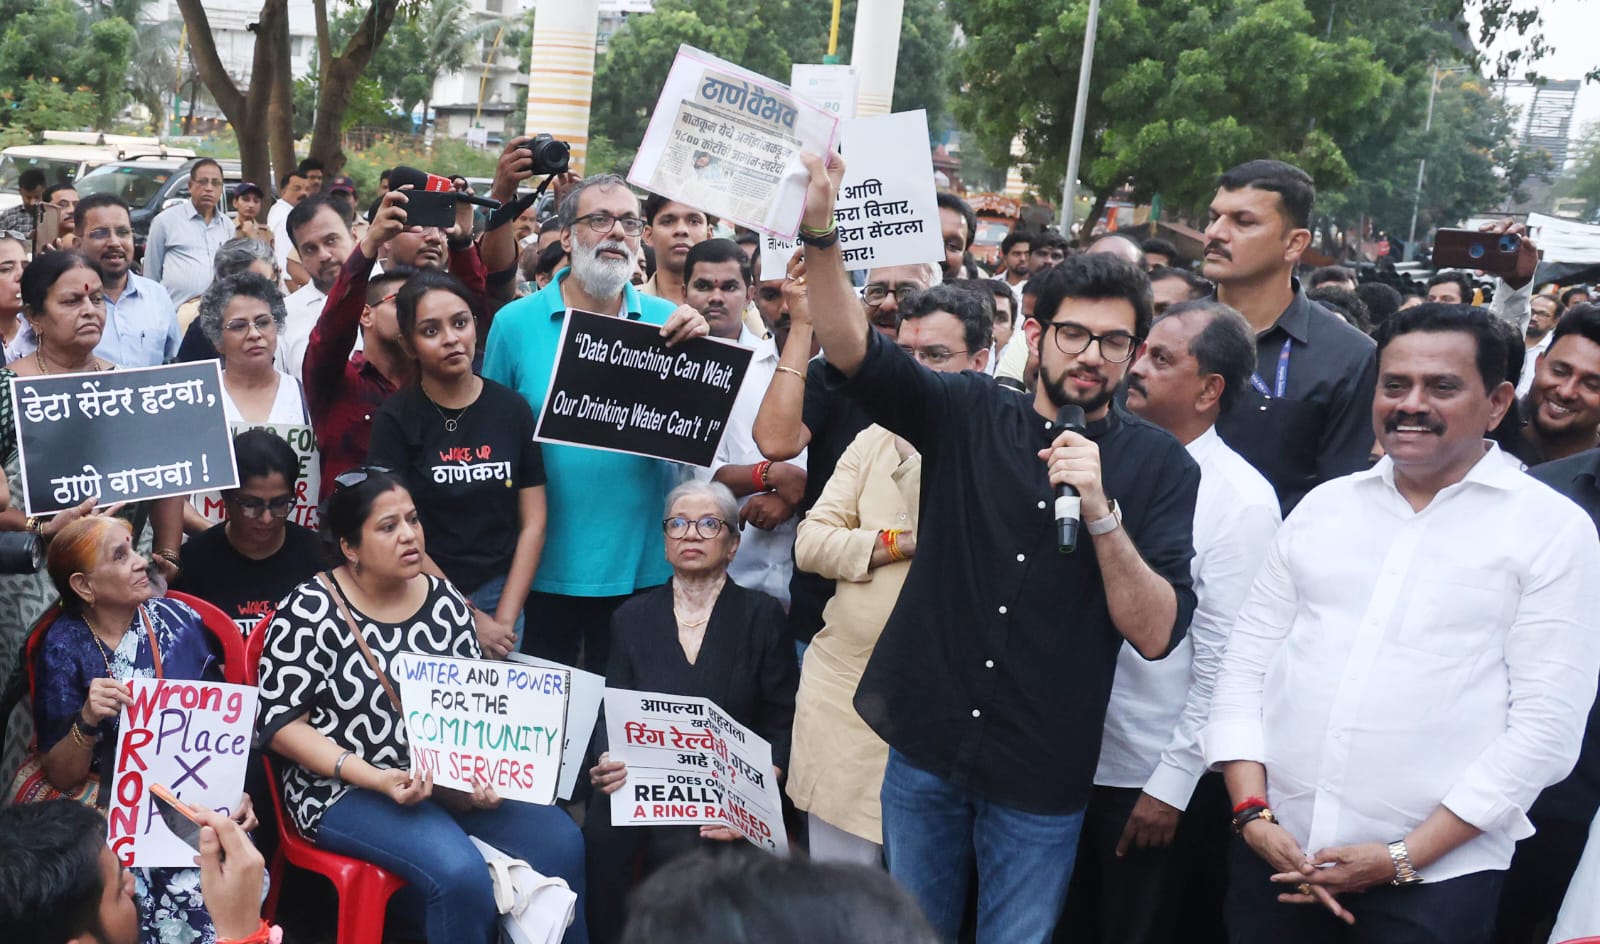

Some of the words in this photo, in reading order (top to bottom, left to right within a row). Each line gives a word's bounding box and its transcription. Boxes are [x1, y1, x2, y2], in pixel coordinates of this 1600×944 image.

[845, 178, 882, 199] आणि
[863, 200, 914, 218] विचार,
[839, 225, 864, 243] डेटा
[867, 219, 924, 239] सेंटरला
[575, 332, 608, 364] “Data
[609, 340, 674, 380] Crunching
[674, 353, 701, 381] Can
[701, 359, 733, 393] Wait,
[22, 386, 71, 423] डेटा
[76, 381, 135, 419] सेंटर
[138, 379, 215, 415] हटवा,
[552, 390, 578, 417] Our
[577, 394, 630, 431] Drinking
[629, 403, 667, 432] Water
[666, 410, 701, 439] Can’t
[431, 460, 512, 488] ठाणेकर!
[440, 447, 472, 462] WAKE
[476, 445, 492, 460] UP
[51, 464, 103, 504] ठाणे
[107, 460, 193, 495] वाचवा
[237, 600, 270, 615] WAKE
[403, 659, 462, 686] WATER
[466, 668, 499, 687] AND
[506, 669, 564, 695] POWER
[124, 680, 243, 730] Wrong
[431, 689, 469, 712] FOR
[471, 693, 509, 715] THE
[641, 699, 704, 716] आपल्या
[708, 707, 745, 744] शहराला
[156, 708, 246, 756] Place
[408, 711, 558, 756] COMMUNITY
[413, 745, 441, 775] NOT
[449, 751, 534, 789] SERVERS
[624, 721, 665, 746] रिंग
[670, 726, 728, 764] रेल्वेची
[730, 752, 765, 789] गरज
[677, 753, 708, 768] आहे
[712, 757, 726, 776] का
[634, 785, 724, 805] REALLY
[728, 800, 771, 837] NEED
[667, 775, 702, 785] DOES
[705, 778, 726, 793] OUR
[728, 790, 745, 808] CITY
[633, 805, 647, 818] A
[653, 804, 698, 818] RING
[704, 804, 764, 846] RAILWAY
